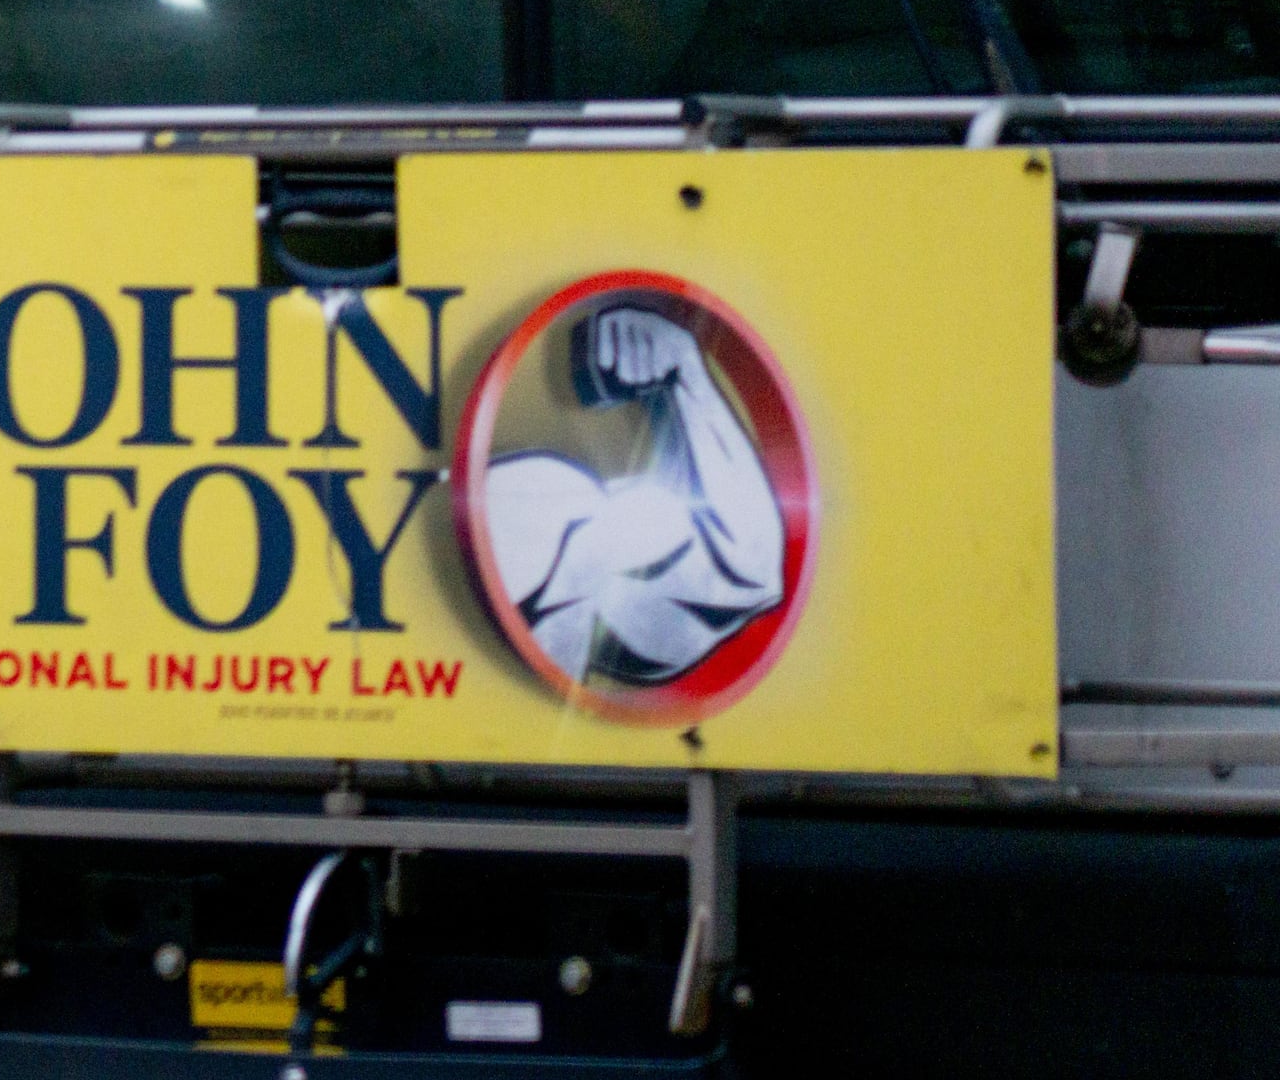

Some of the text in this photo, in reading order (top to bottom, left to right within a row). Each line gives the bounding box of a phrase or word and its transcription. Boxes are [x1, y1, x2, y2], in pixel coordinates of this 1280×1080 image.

[14, 464, 440, 634] FOY
[148, 654, 330, 697] INJURY
[351, 658, 464, 700] LAW
